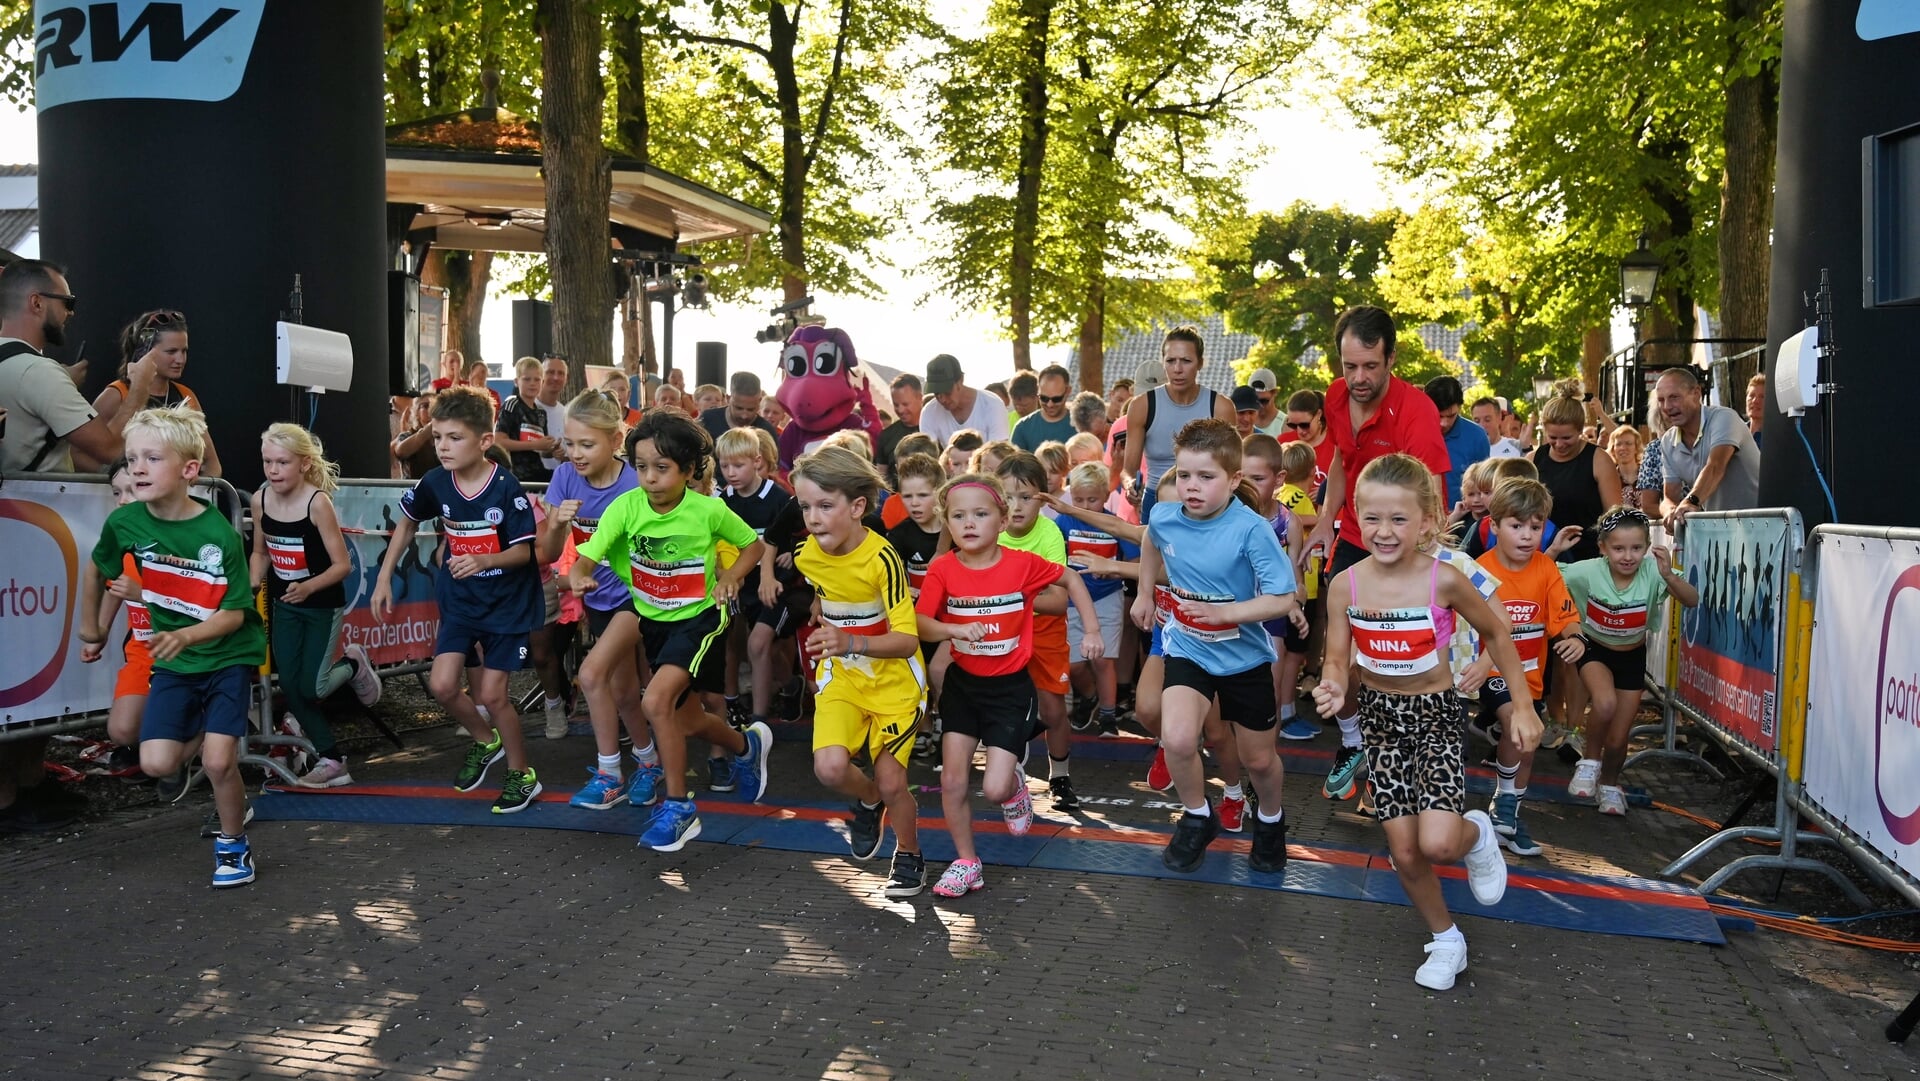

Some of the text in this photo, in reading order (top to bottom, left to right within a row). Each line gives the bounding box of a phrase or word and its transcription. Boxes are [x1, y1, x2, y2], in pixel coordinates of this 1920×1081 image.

[1506, 605, 1536, 613] PORT
[1510, 613, 1531, 621] AYS
[1602, 616, 1625, 626] TESS
[1380, 622, 1395, 630] 435
[1369, 639, 1411, 652] NINA
